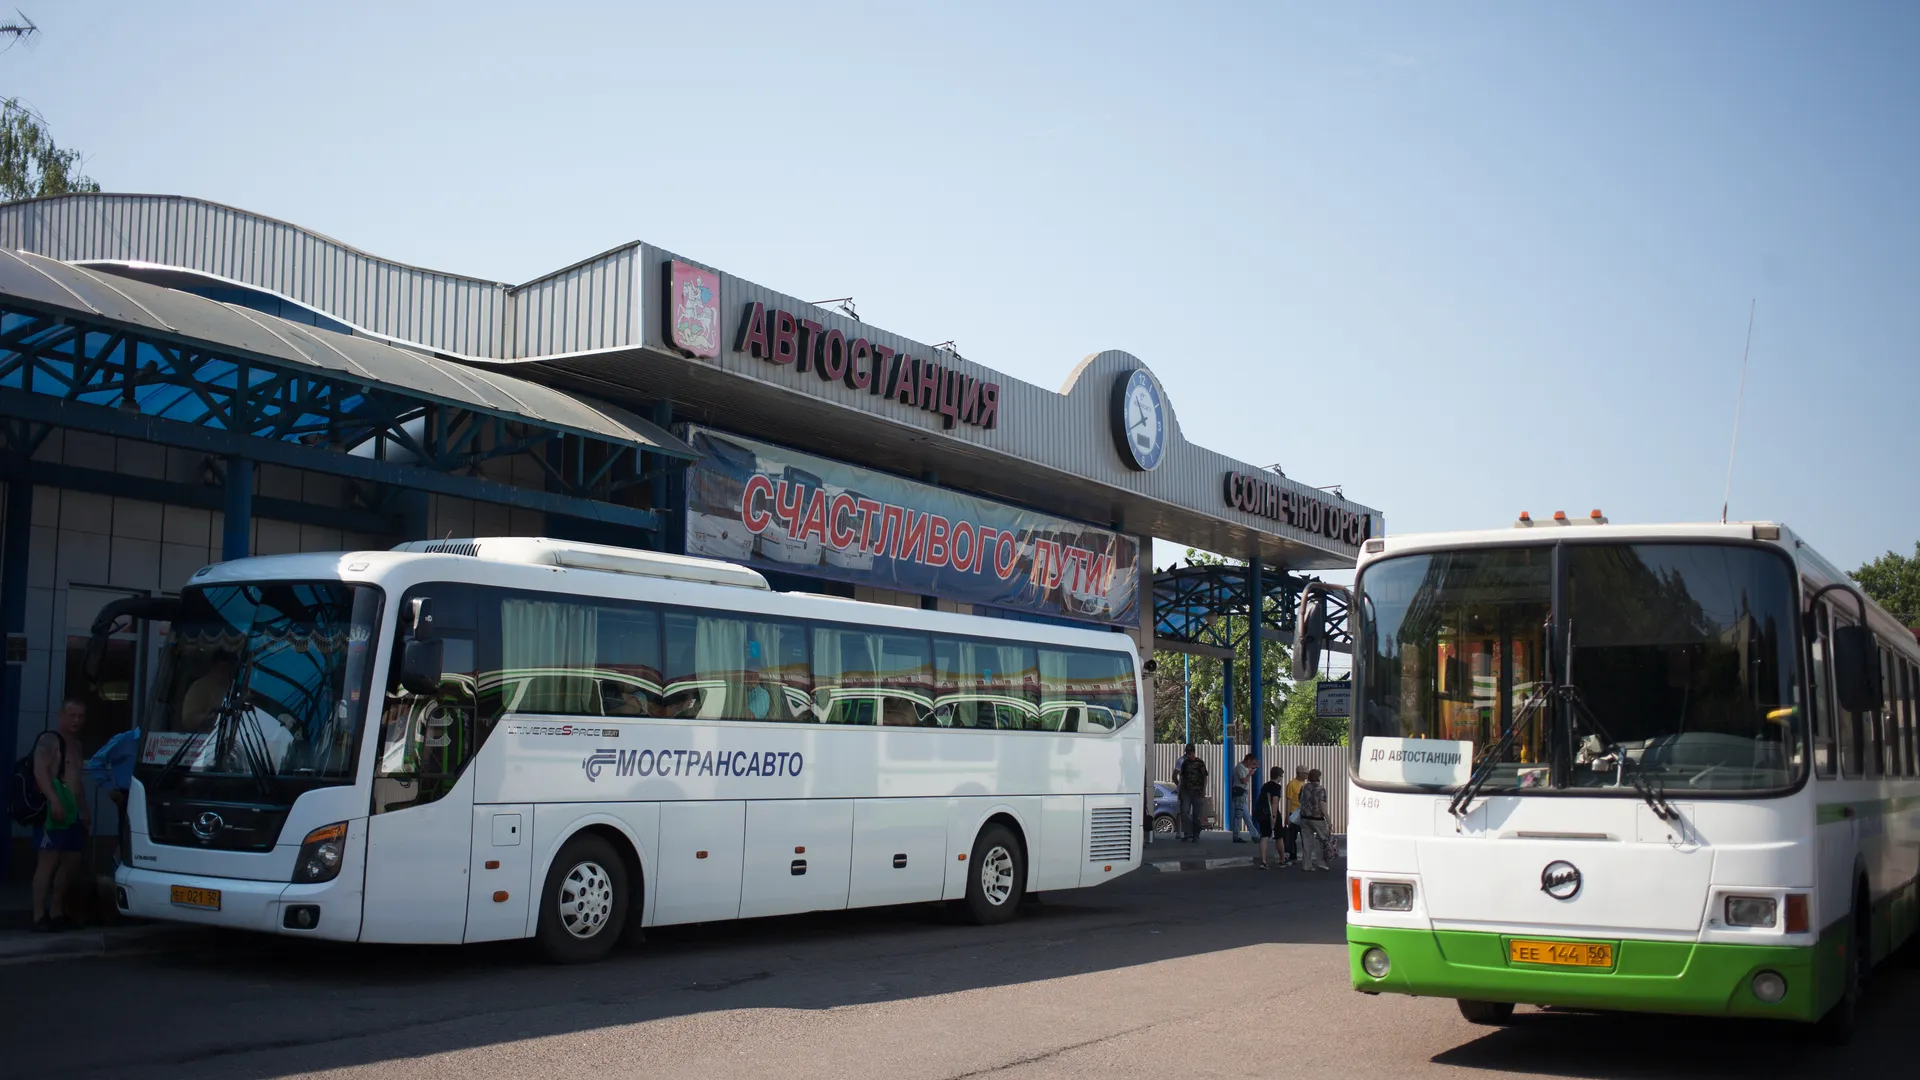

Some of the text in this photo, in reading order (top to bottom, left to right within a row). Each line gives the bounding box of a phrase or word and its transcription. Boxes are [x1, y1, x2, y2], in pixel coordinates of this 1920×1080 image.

[735, 301, 999, 429] АВТОСТАНЦИЯ
[1139, 374, 1146, 386] 12
[1226, 471, 1367, 547] СОЛНЕЧНОГОРСК
[741, 473, 1112, 599] СЧАСТЛИВОГО ПУТИ!
[615, 749, 804, 777] МОСТРАНСАВТО
[1371, 748, 1462, 765] ДО АВТОСТАНЦИИ
[1547, 944, 1578, 962] 144
[1588, 946, 1605, 959] 50
